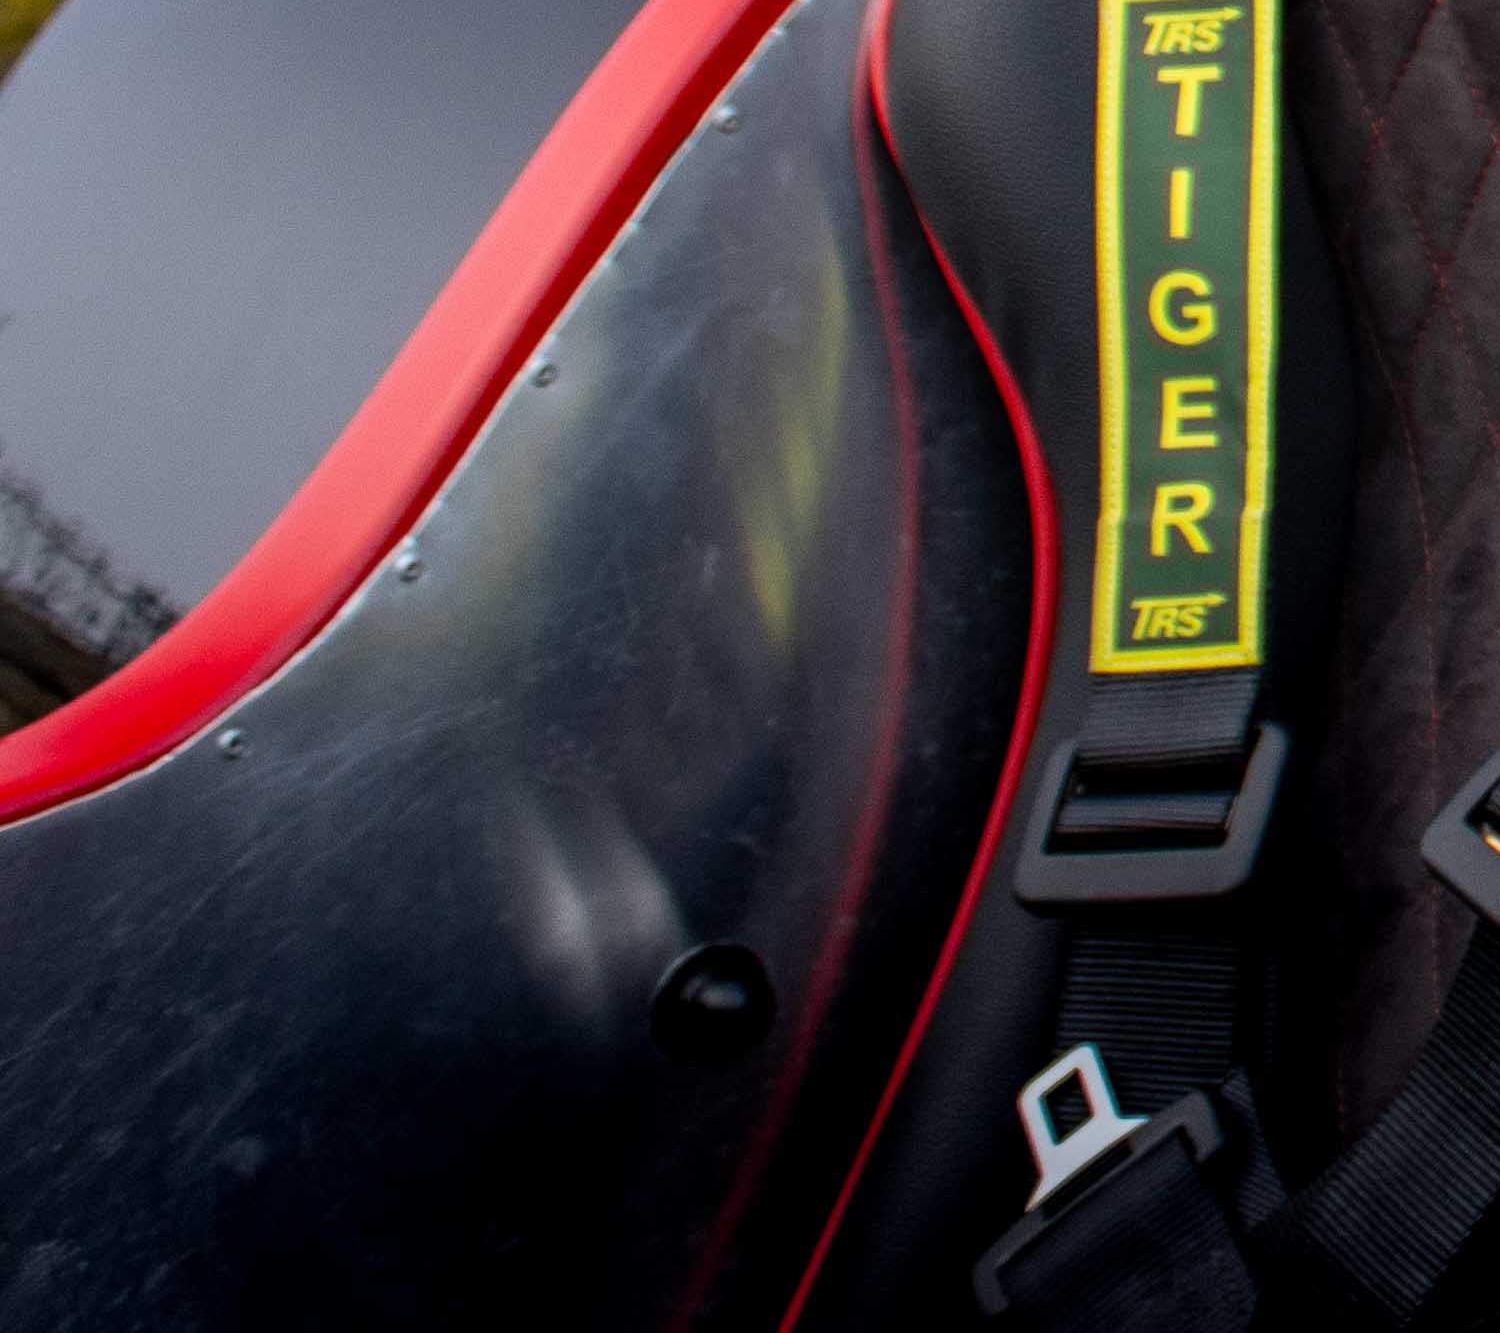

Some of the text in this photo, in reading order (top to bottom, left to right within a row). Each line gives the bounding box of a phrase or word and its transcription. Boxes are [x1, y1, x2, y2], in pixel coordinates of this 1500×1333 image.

[1143, 6, 1240, 56] TRS
[1147, 64, 1221, 557] TIGER
[1131, 592, 1226, 640] TRS
